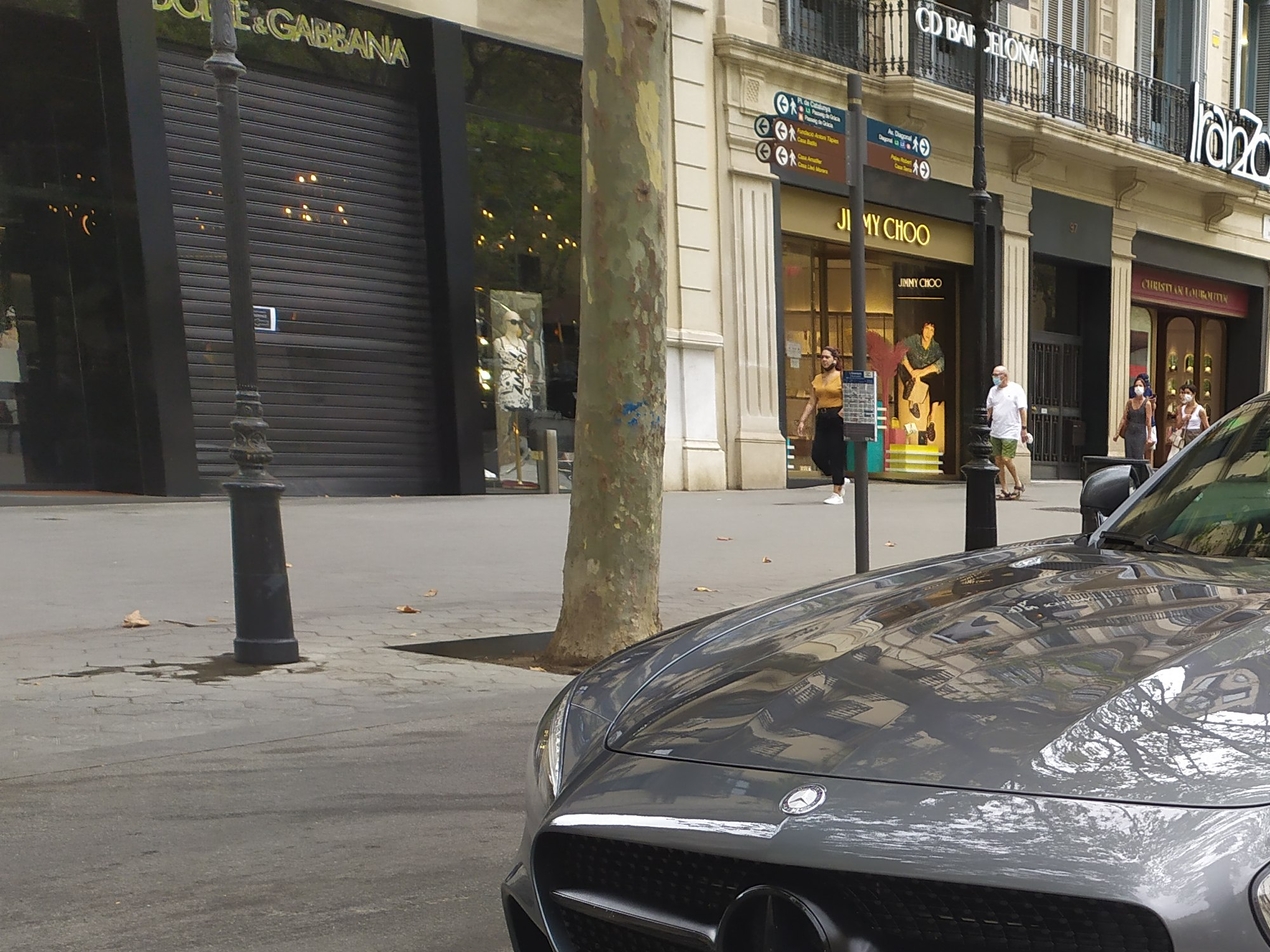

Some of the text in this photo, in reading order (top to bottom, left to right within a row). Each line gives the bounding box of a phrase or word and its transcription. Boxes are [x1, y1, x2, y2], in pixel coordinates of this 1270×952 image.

[878, 134, 893, 143] Diagonal
[894, 130, 912, 141] Diagonal
[837, 208, 931, 246] JIMY CHOO
[898, 278, 942, 288] JIMMY CHOO
[1141, 279, 1229, 304] CHRISTIAN LOUBOUTIN
